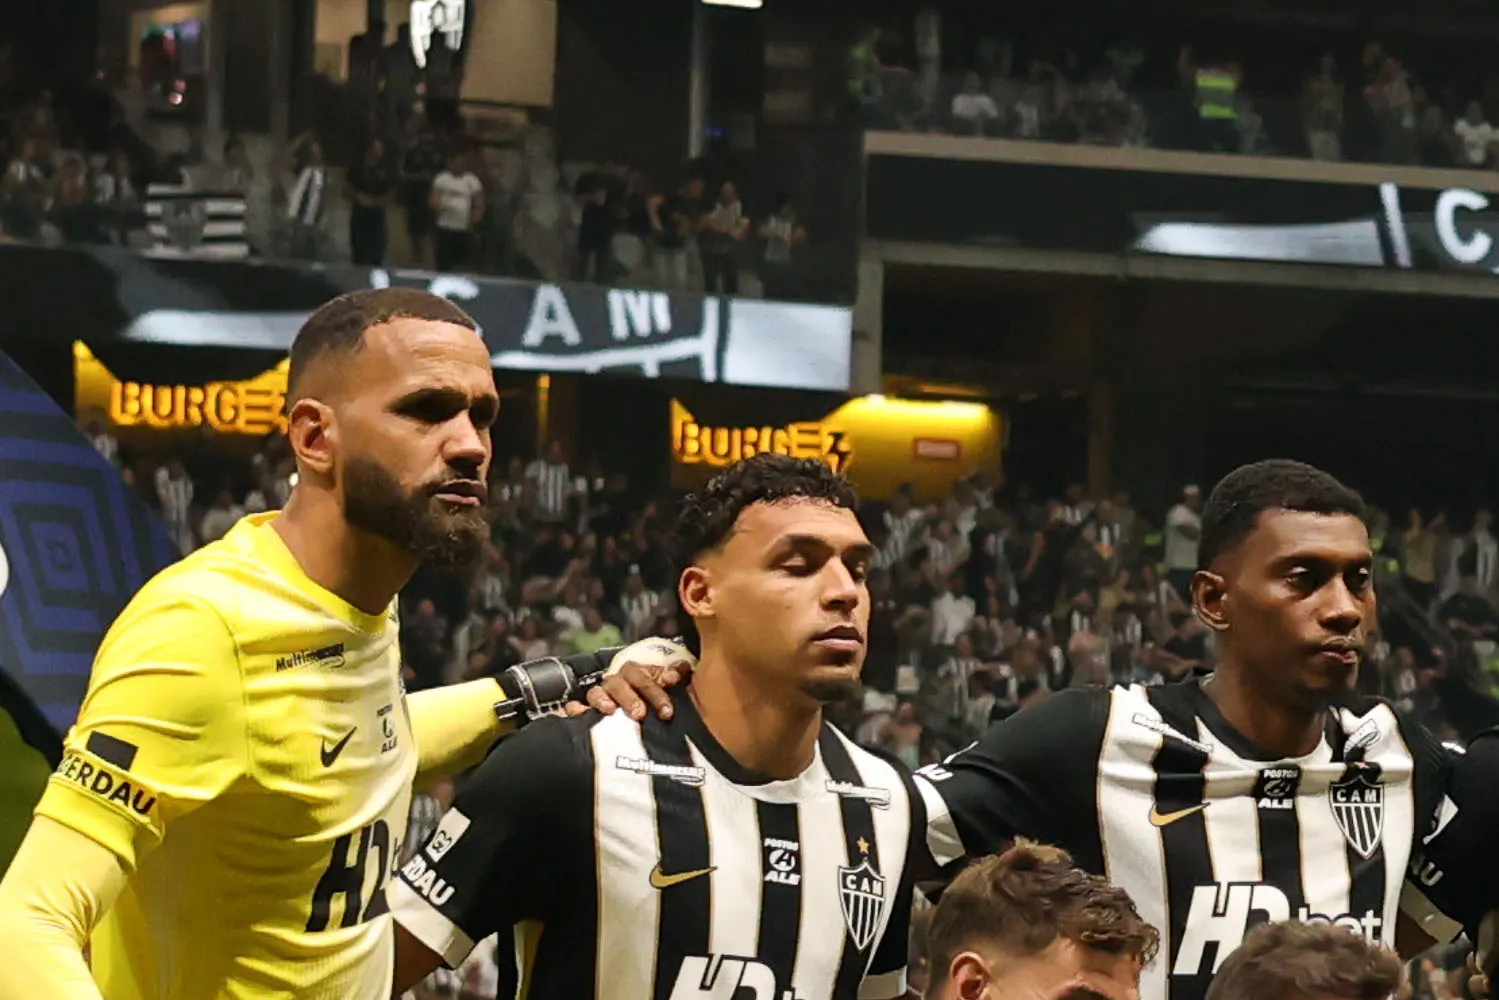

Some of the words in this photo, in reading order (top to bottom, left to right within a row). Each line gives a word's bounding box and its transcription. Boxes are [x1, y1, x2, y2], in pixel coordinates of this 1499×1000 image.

[110, 381, 290, 436] BURGE
[1336, 788, 1378, 803] CAM
[1258, 797, 1293, 810] ALE
[764, 870, 801, 886] ALE
